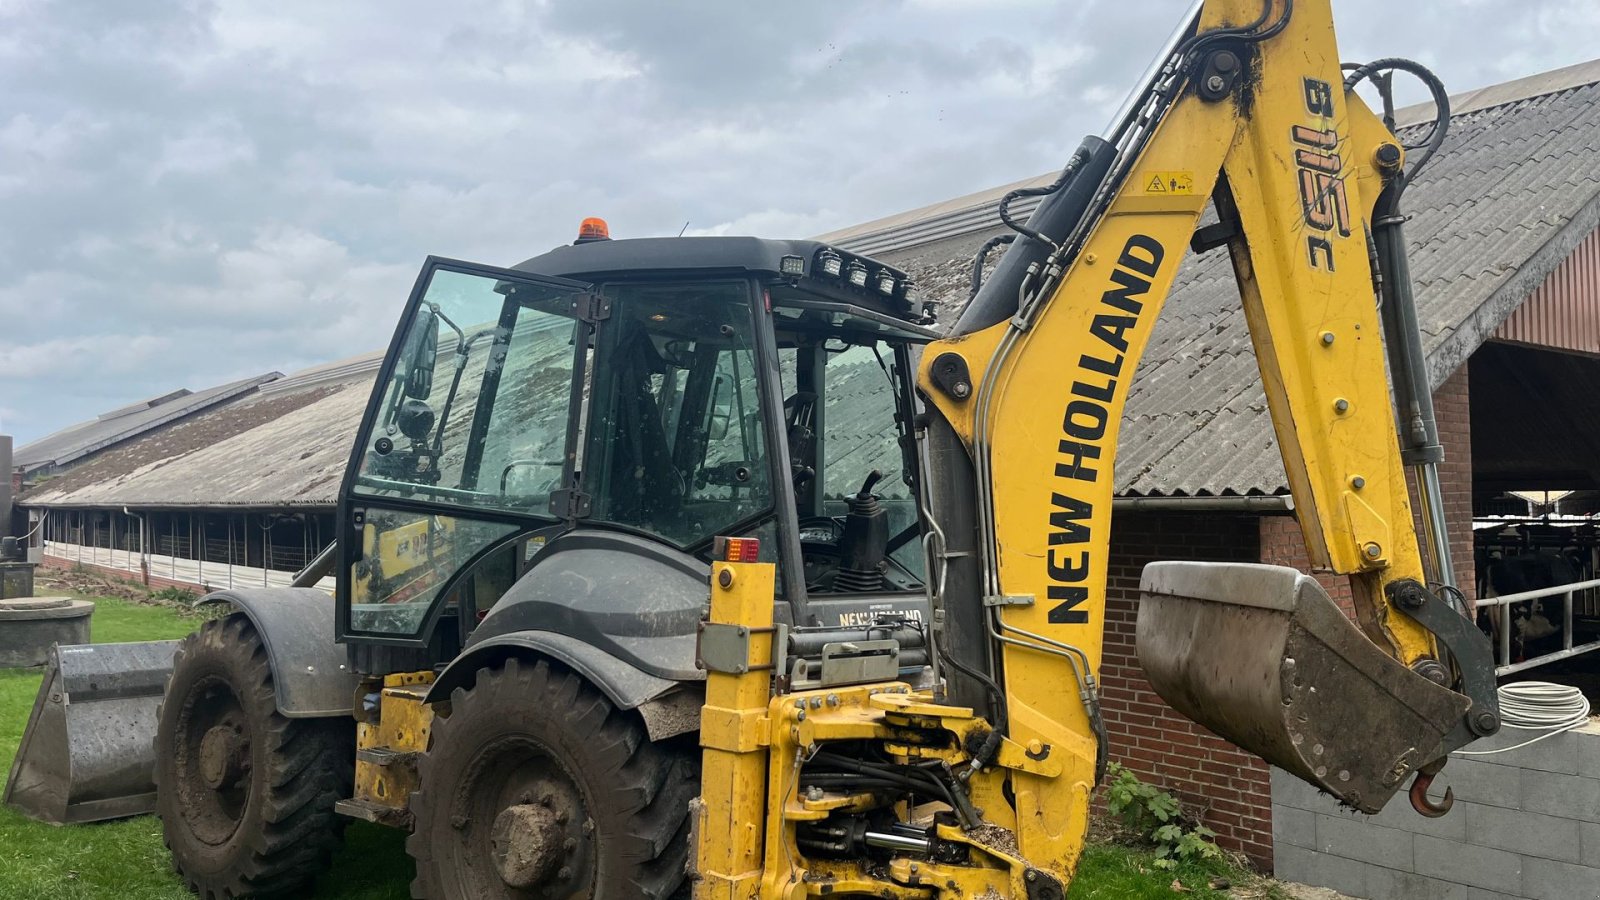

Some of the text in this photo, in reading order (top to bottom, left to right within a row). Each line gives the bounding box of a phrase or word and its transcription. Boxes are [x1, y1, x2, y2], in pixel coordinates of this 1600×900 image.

[1047, 234, 1165, 624] NEW HOLLAND
[839, 612, 868, 630] NEW
